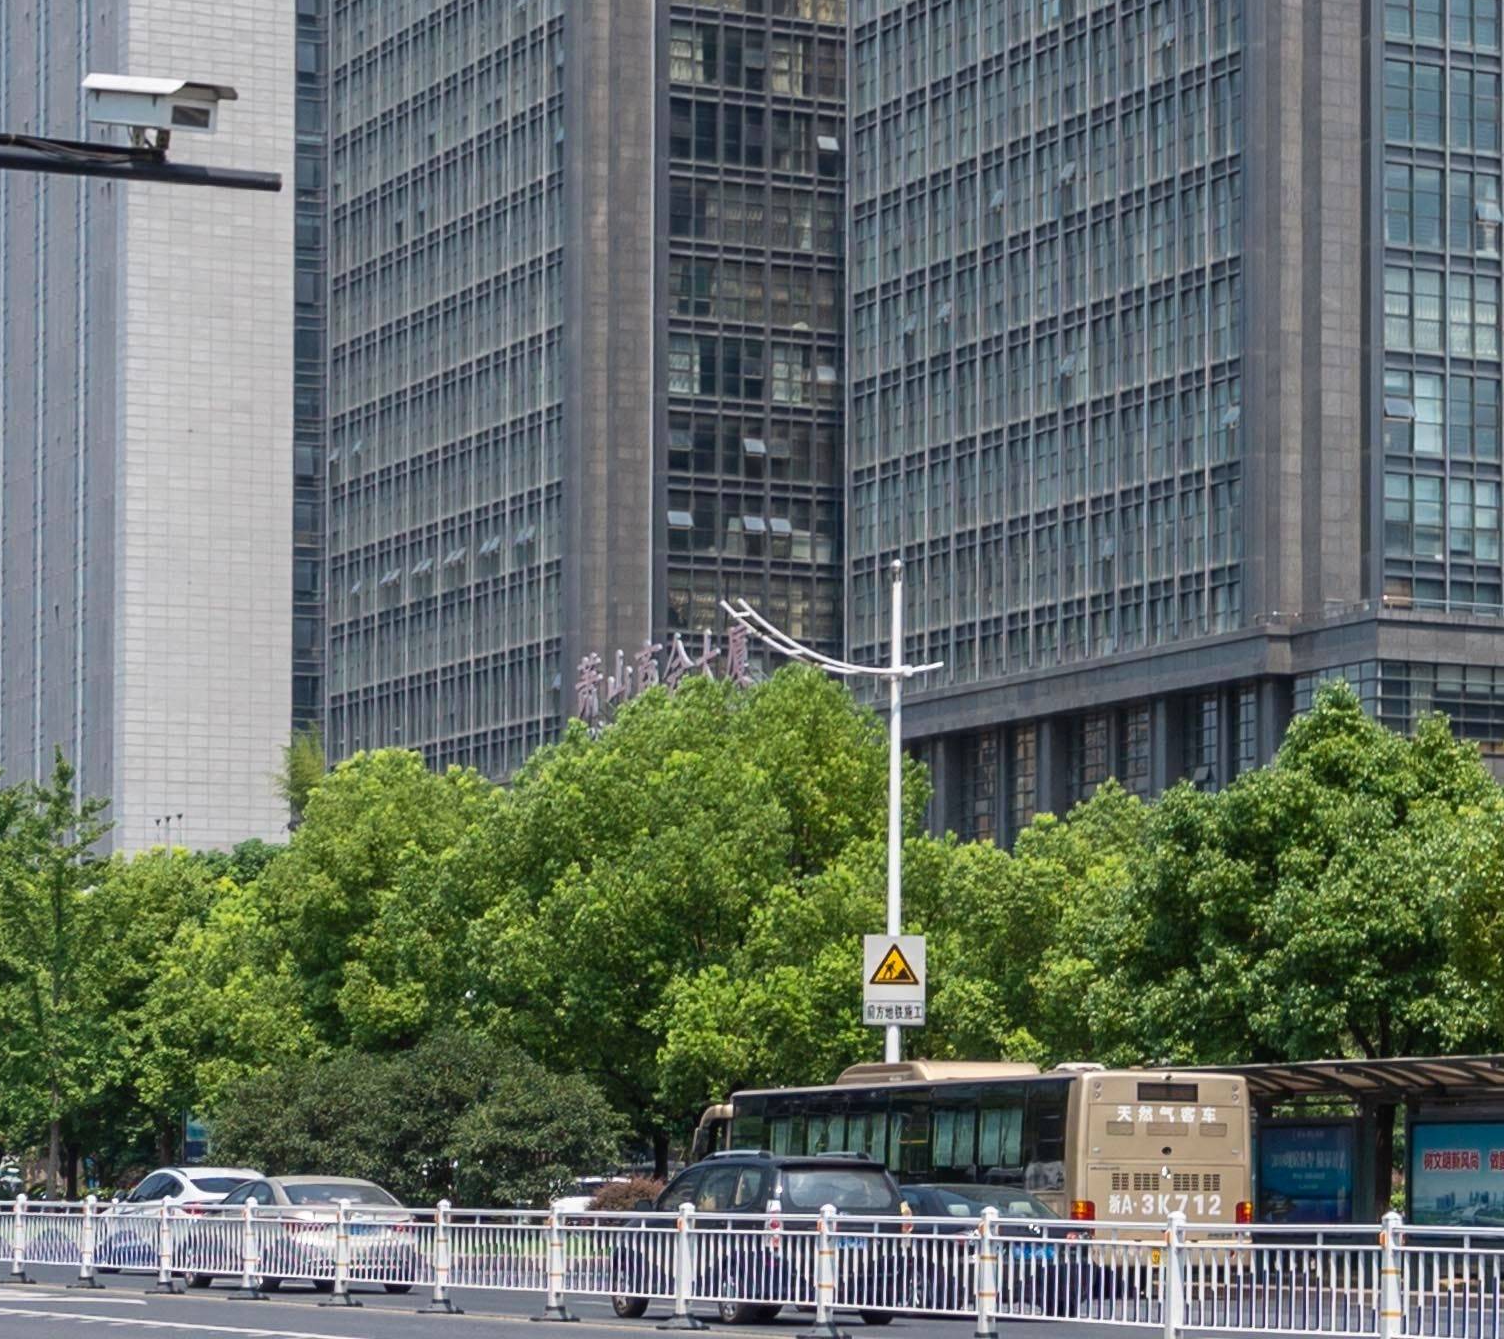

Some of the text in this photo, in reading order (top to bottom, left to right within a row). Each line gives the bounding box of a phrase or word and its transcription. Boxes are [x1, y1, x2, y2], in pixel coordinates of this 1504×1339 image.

[1117, 1105, 1217, 1123] 天然气客车
[1424, 1150, 1480, 1171] 树文明新风尚
